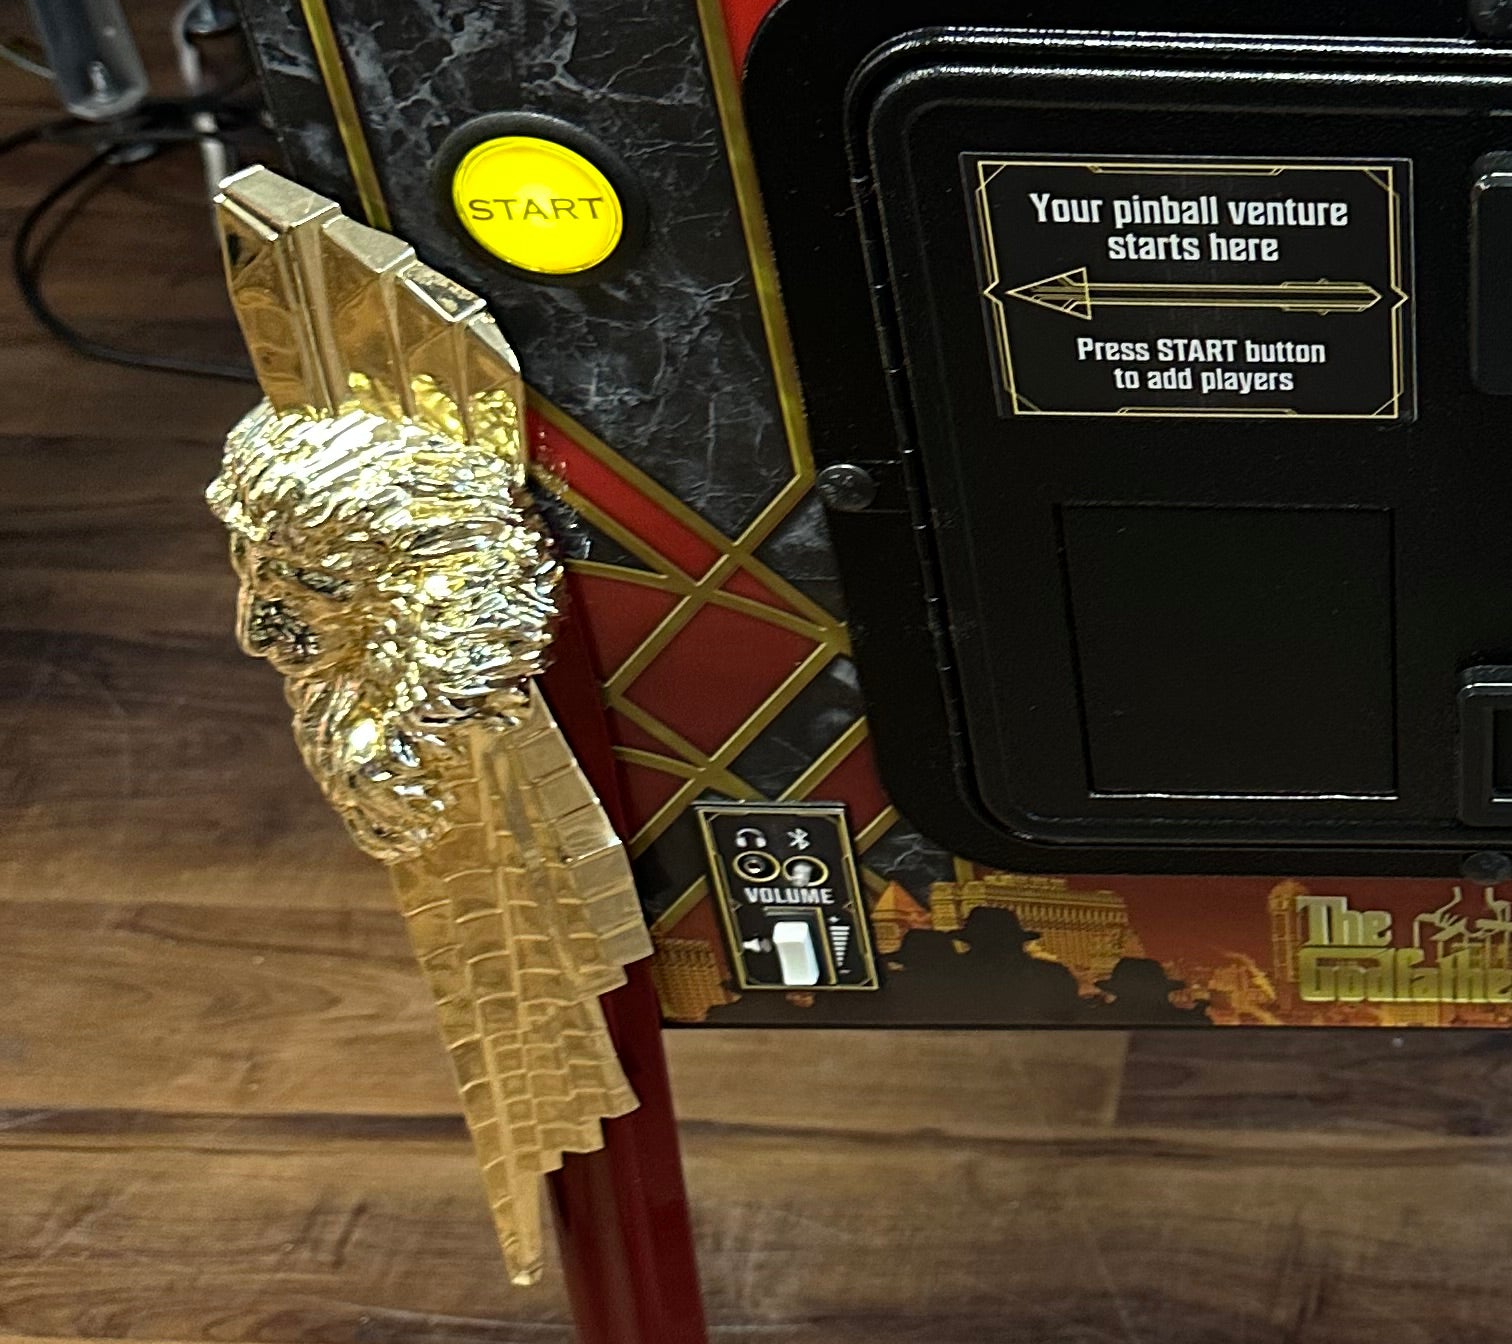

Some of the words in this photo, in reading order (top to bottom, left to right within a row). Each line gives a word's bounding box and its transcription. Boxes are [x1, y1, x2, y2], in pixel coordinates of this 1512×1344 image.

[469, 197, 603, 221] START
[1029, 192, 1103, 223] Your
[1113, 194, 1219, 229] pinball
[1227, 198, 1348, 226] venture
[1107, 233, 1201, 261] starts
[1208, 232, 1279, 262] here
[1076, 337, 1150, 361] Press
[1156, 338, 1238, 362] START
[1244, 339, 1326, 363] button
[1113, 367, 1140, 390] to
[1146, 367, 1193, 390] add
[1200, 367, 1294, 395] players
[744, 887, 835, 904] VOLUME
[1297, 896, 1393, 947] The
